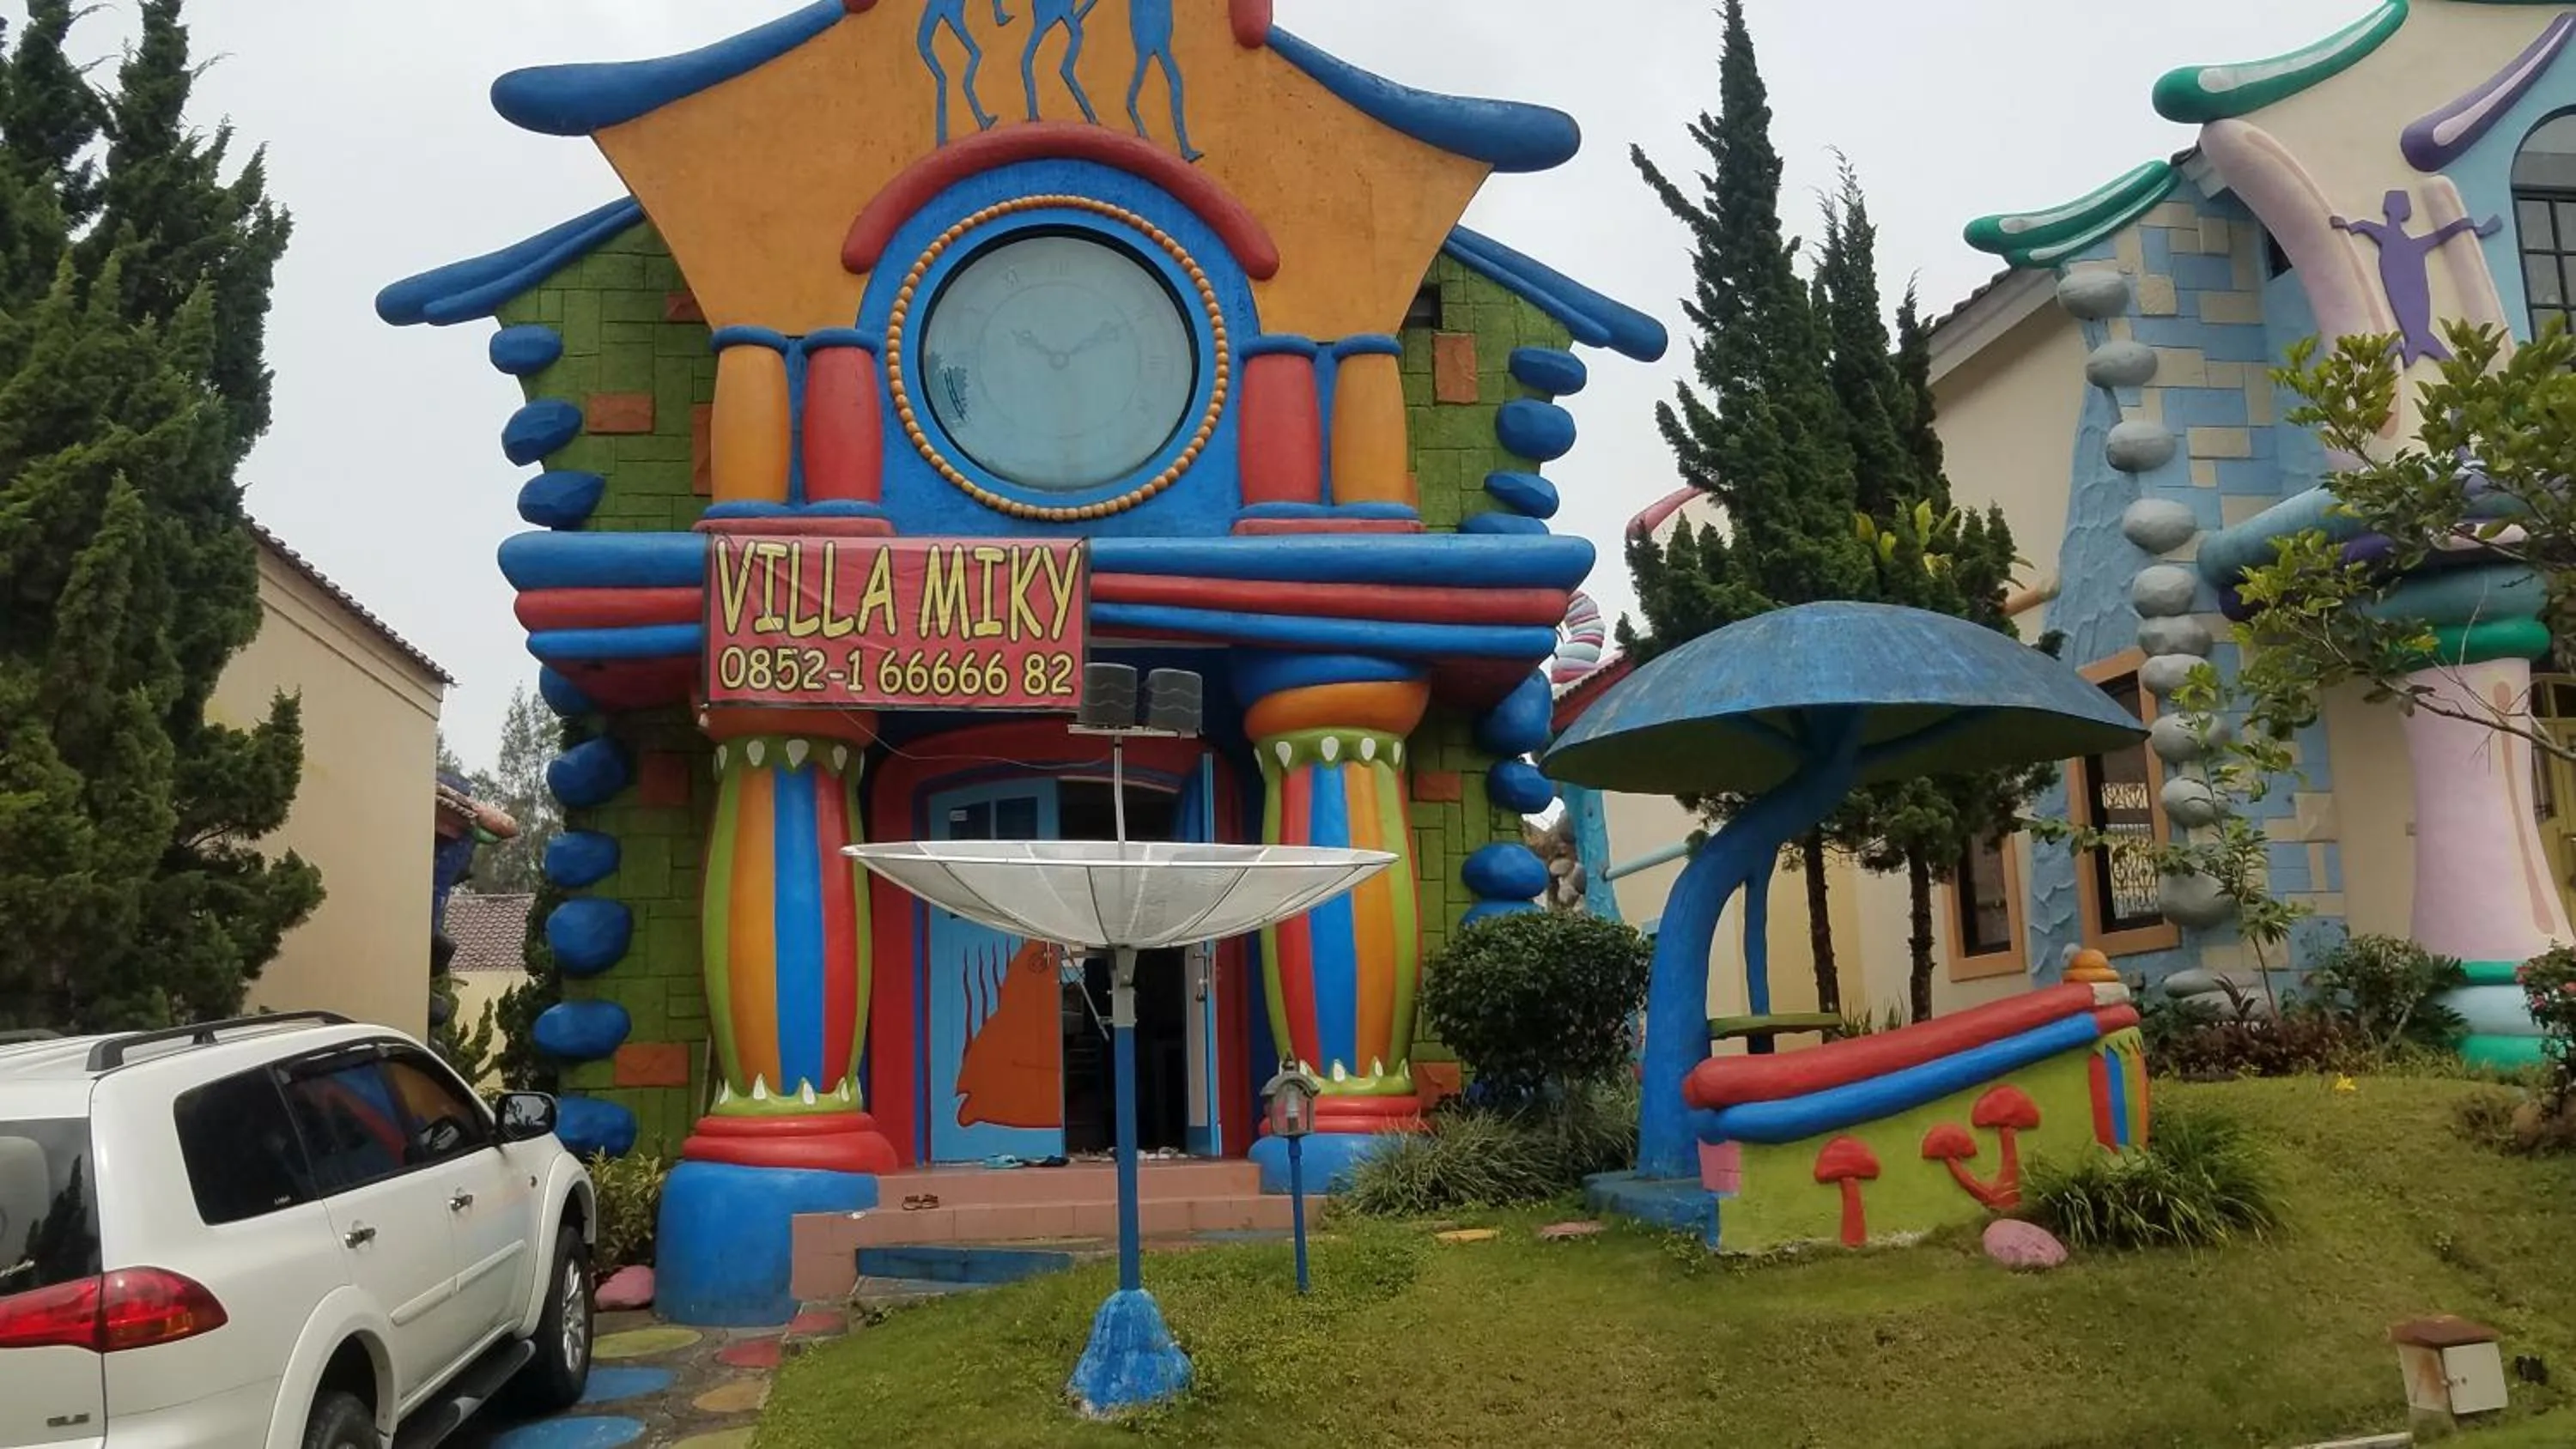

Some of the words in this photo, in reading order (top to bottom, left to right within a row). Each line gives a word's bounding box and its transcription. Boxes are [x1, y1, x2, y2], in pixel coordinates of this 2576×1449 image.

[715, 540, 897, 639] VILLA
[919, 543, 1082, 642] MIKY
[720, 645, 864, 693] 0852-1
[878, 650, 1010, 696] 66666
[1023, 652, 1075, 696] 82
